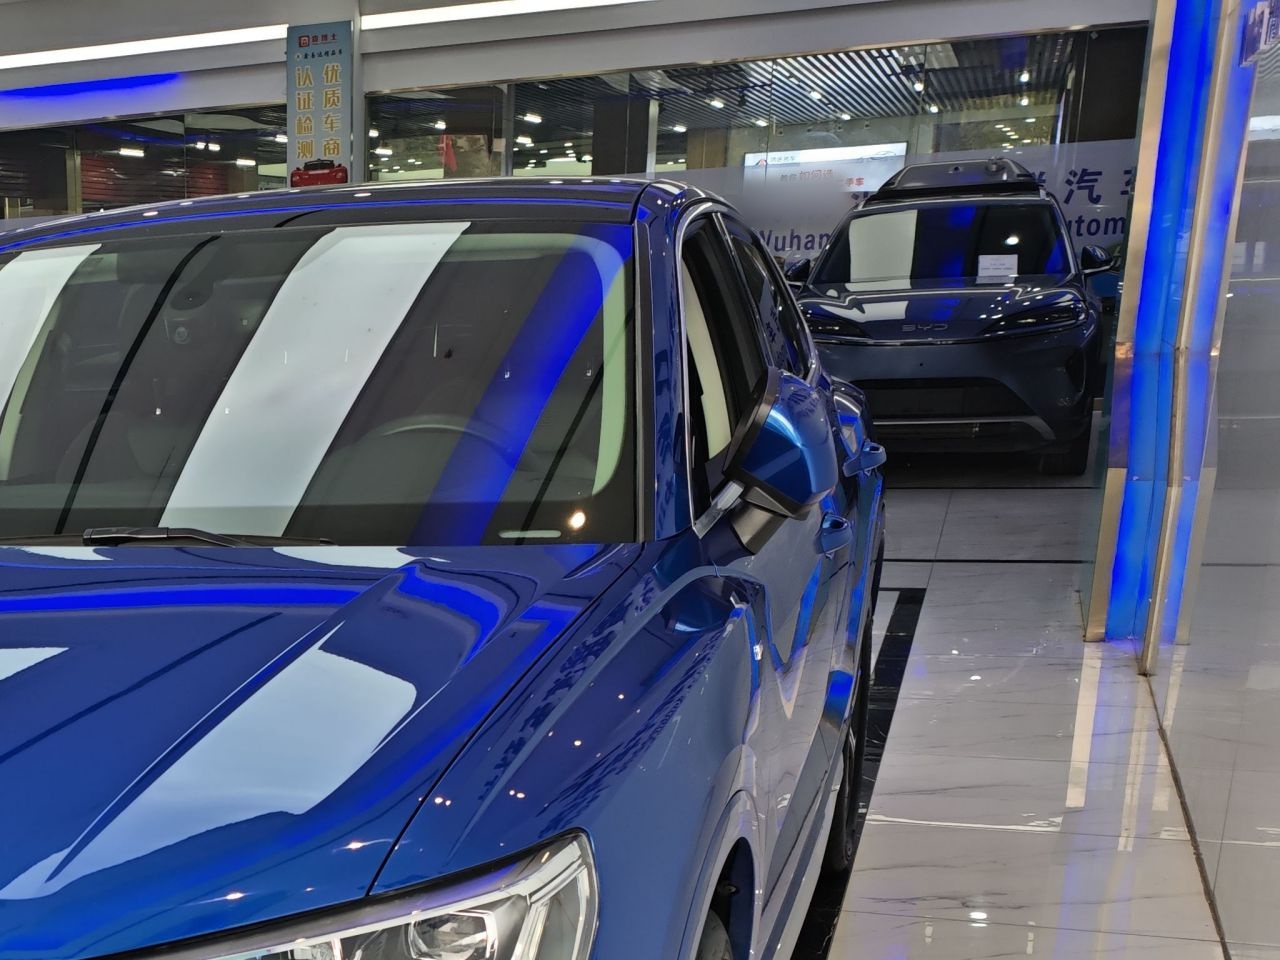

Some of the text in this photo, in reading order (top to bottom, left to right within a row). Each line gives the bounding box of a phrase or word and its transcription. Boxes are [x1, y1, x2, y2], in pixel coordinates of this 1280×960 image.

[296, 68, 314, 159] 认证检测
[322, 64, 341, 157] 优质车商
[902, 323, 949, 332] BYD
